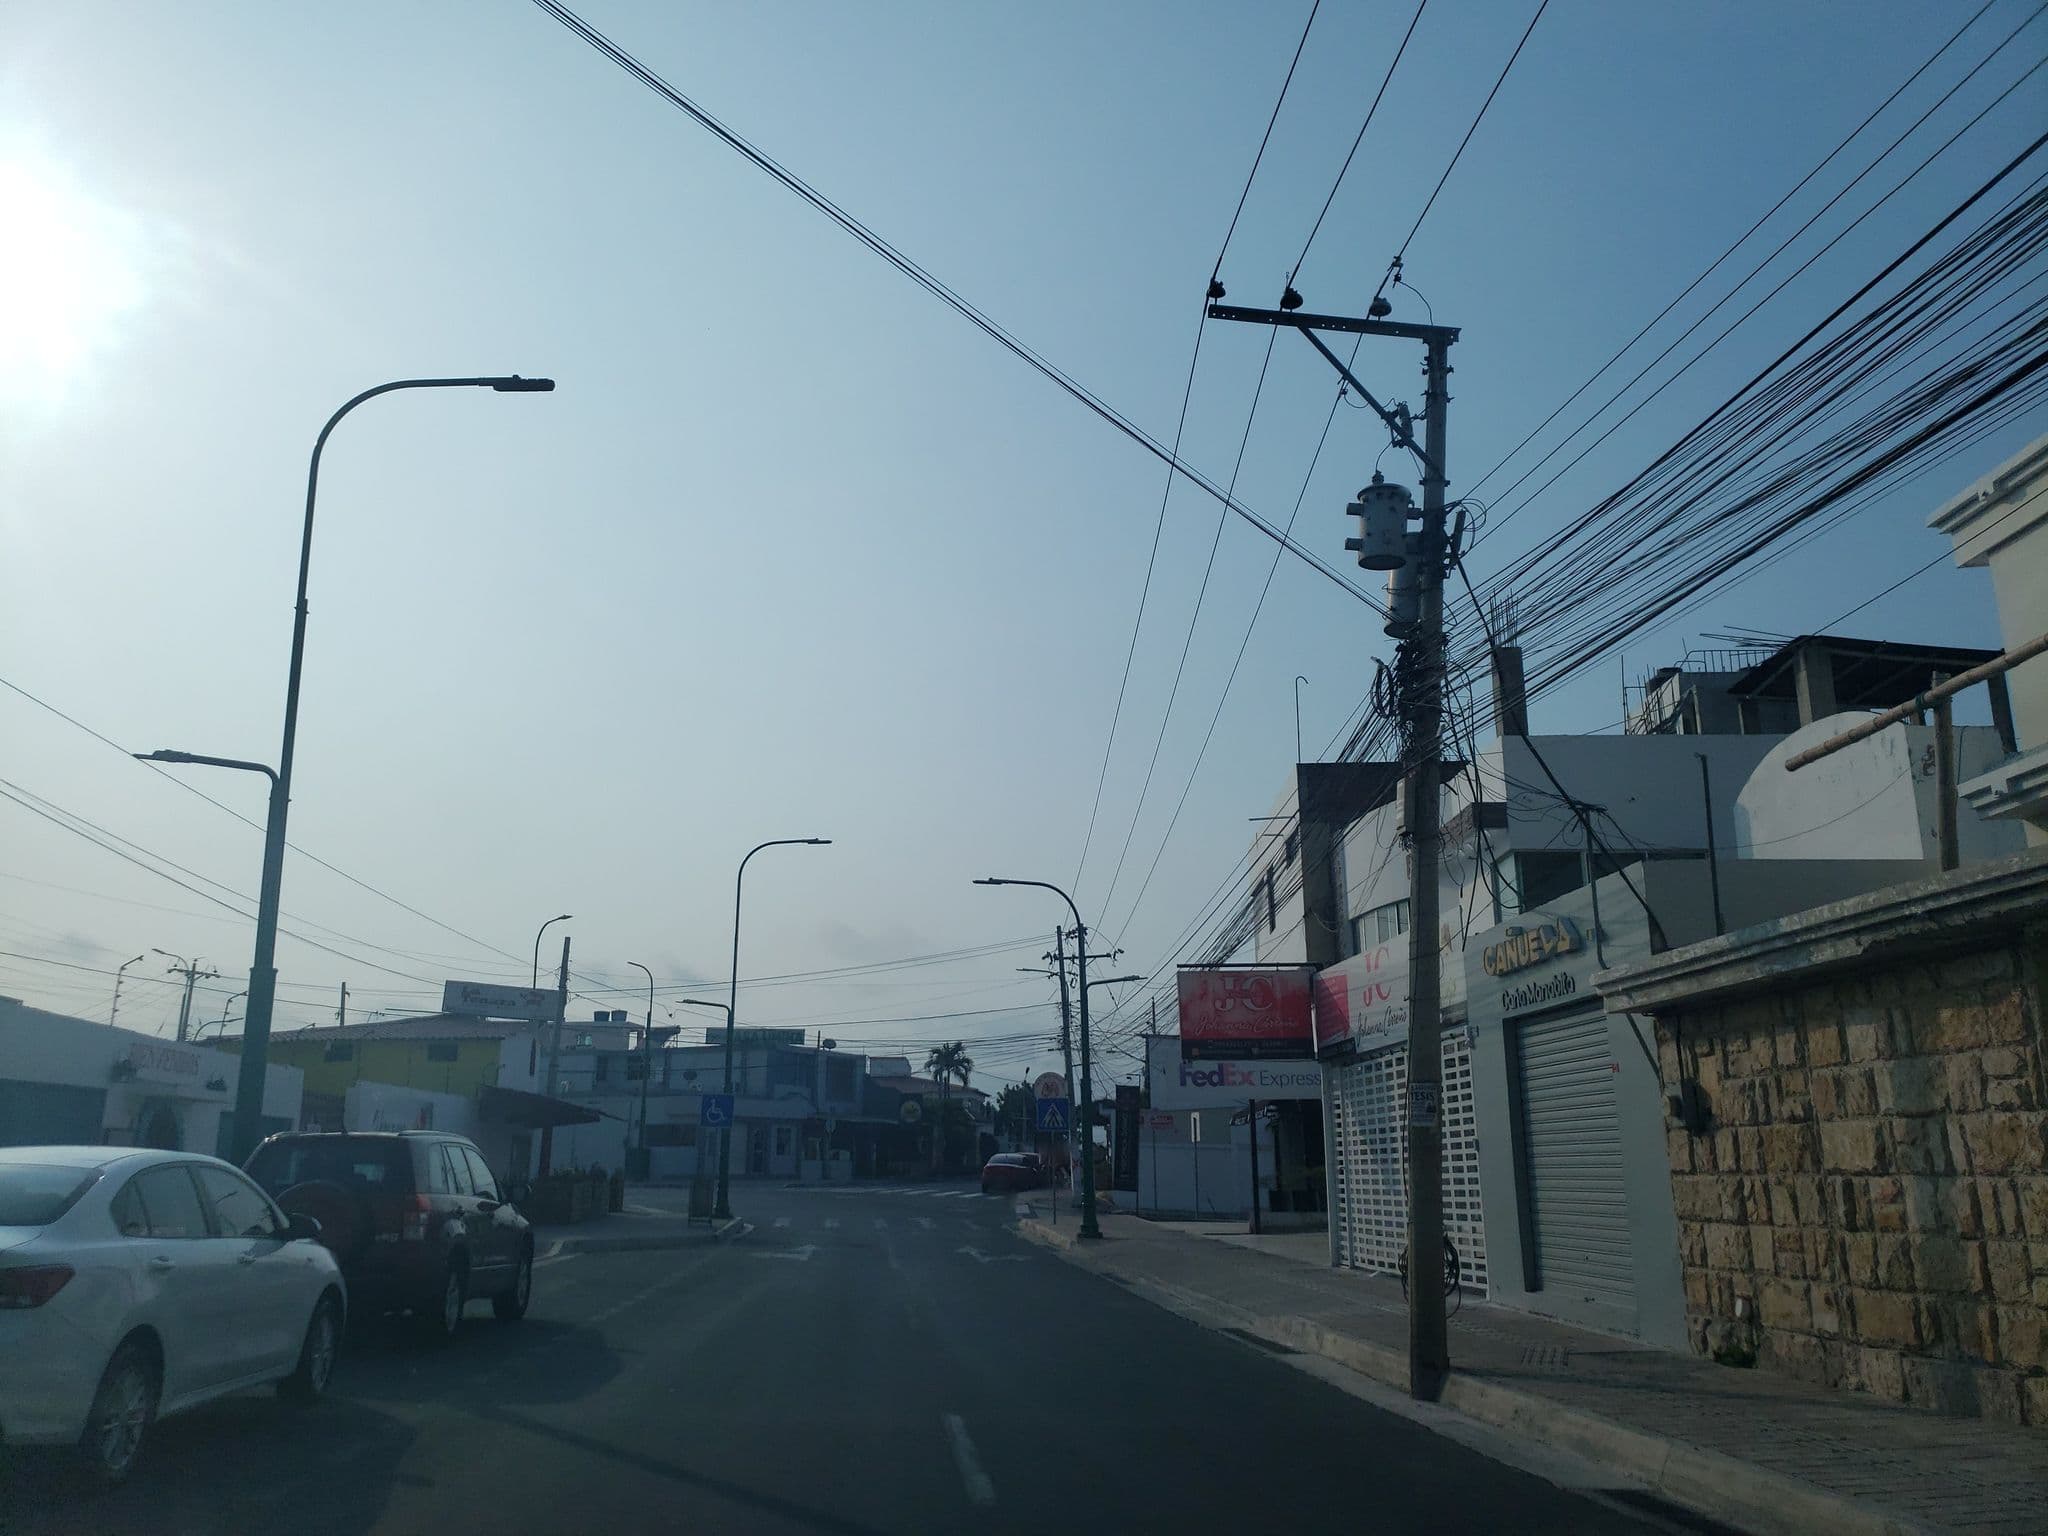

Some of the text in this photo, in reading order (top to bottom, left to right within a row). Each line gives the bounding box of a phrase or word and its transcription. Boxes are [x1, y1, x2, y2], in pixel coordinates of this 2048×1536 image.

[1484, 917, 1578, 976] CAÑUELA
[1363, 947, 1395, 1007] JC
[1180, 1062, 1321, 1088] FedEx Express
